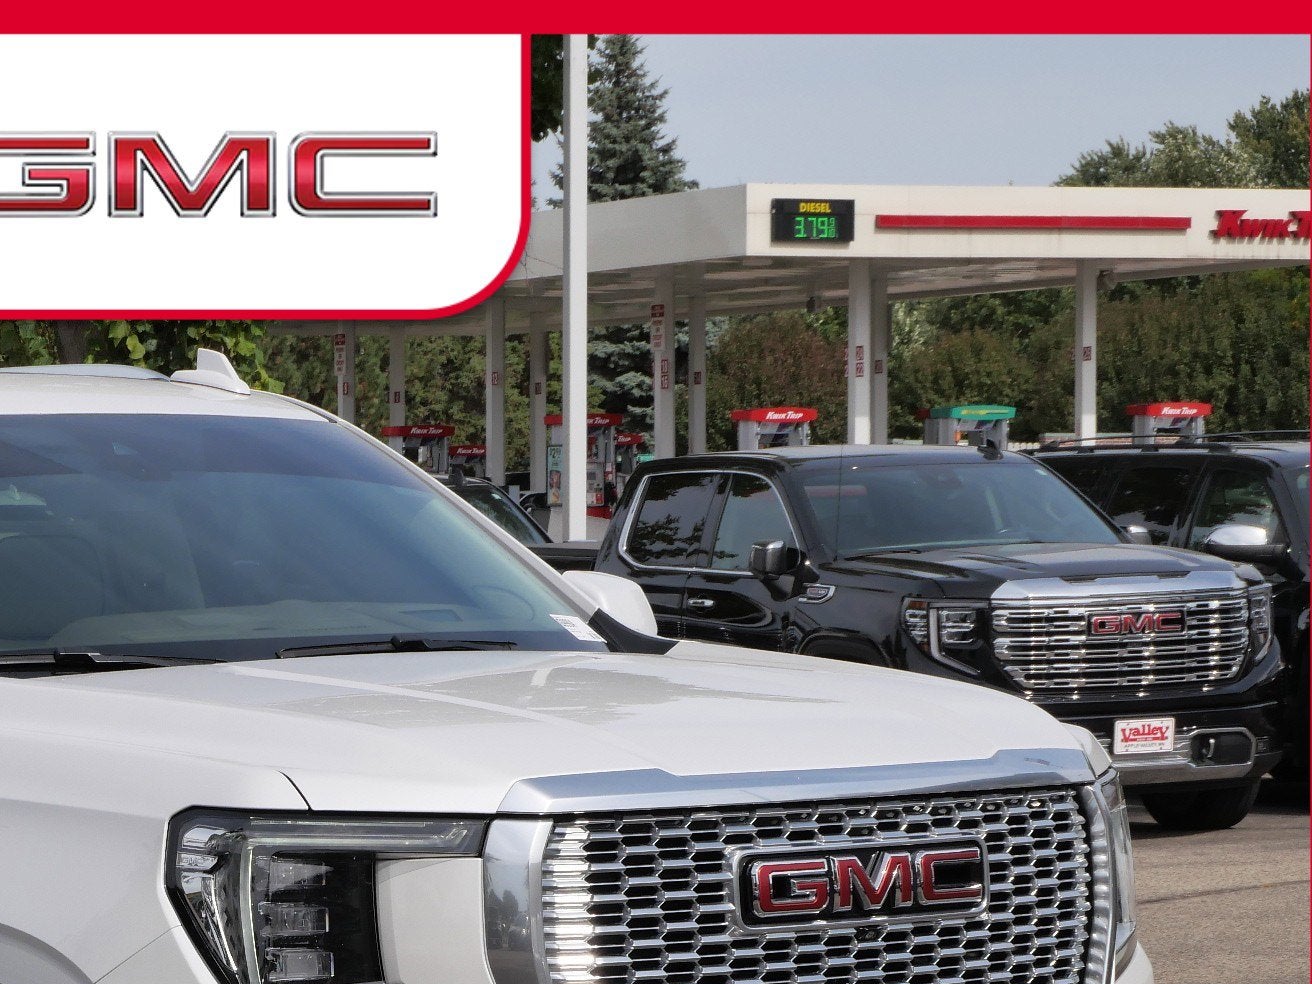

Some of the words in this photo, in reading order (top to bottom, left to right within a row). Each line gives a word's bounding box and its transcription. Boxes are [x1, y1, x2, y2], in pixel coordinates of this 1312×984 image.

[799, 202, 832, 213] DIESEL
[1092, 612, 1182, 635] GMC
[1121, 724, 1169, 742] Valley
[752, 848, 982, 918] GMC
